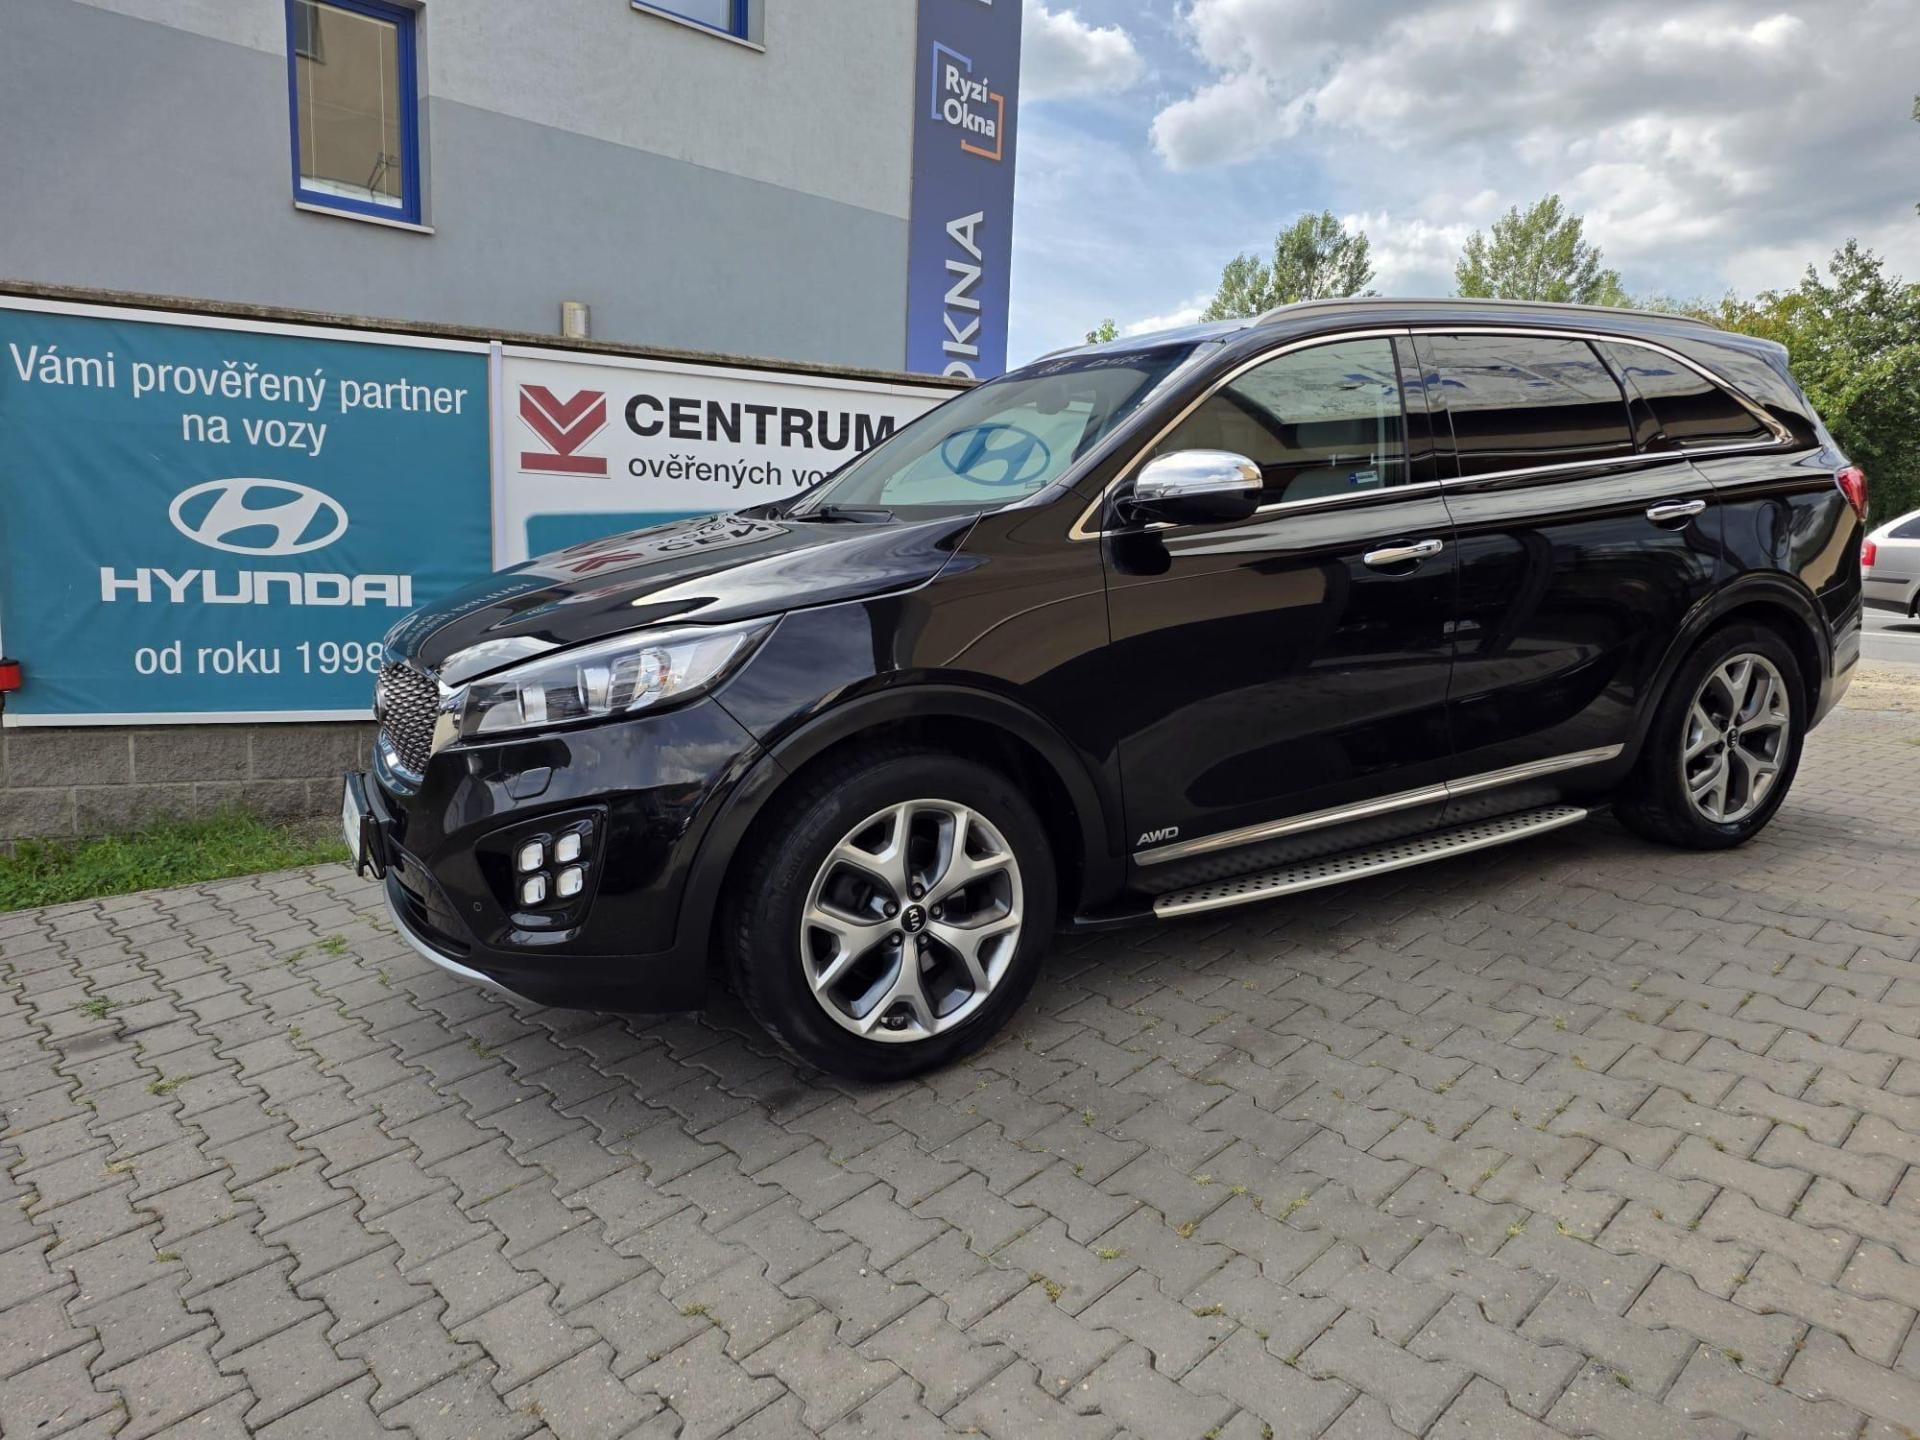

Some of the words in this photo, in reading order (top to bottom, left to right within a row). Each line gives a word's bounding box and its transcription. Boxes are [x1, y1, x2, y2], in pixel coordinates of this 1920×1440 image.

[945, 64, 988, 102] Ryzí
[943, 98, 996, 137] Okna
[9, 343, 115, 388] Vámi
[132, 360, 326, 412] prověřený
[340, 378, 468, 415] partner
[182, 414, 230, 444] na
[243, 418, 327, 457] vozy
[625, 394, 895, 452] CENTRUM
[628, 453, 782, 490] ověřených
[791, 468, 833, 487] vo
[100, 566, 413, 607] HYUNDAI
[135, 640, 182, 675] od
[198, 640, 280, 674] roku
[296, 641, 385, 675] 1998
[1136, 826, 1179, 846] AWD
[908, 908, 921, 931] KIA
